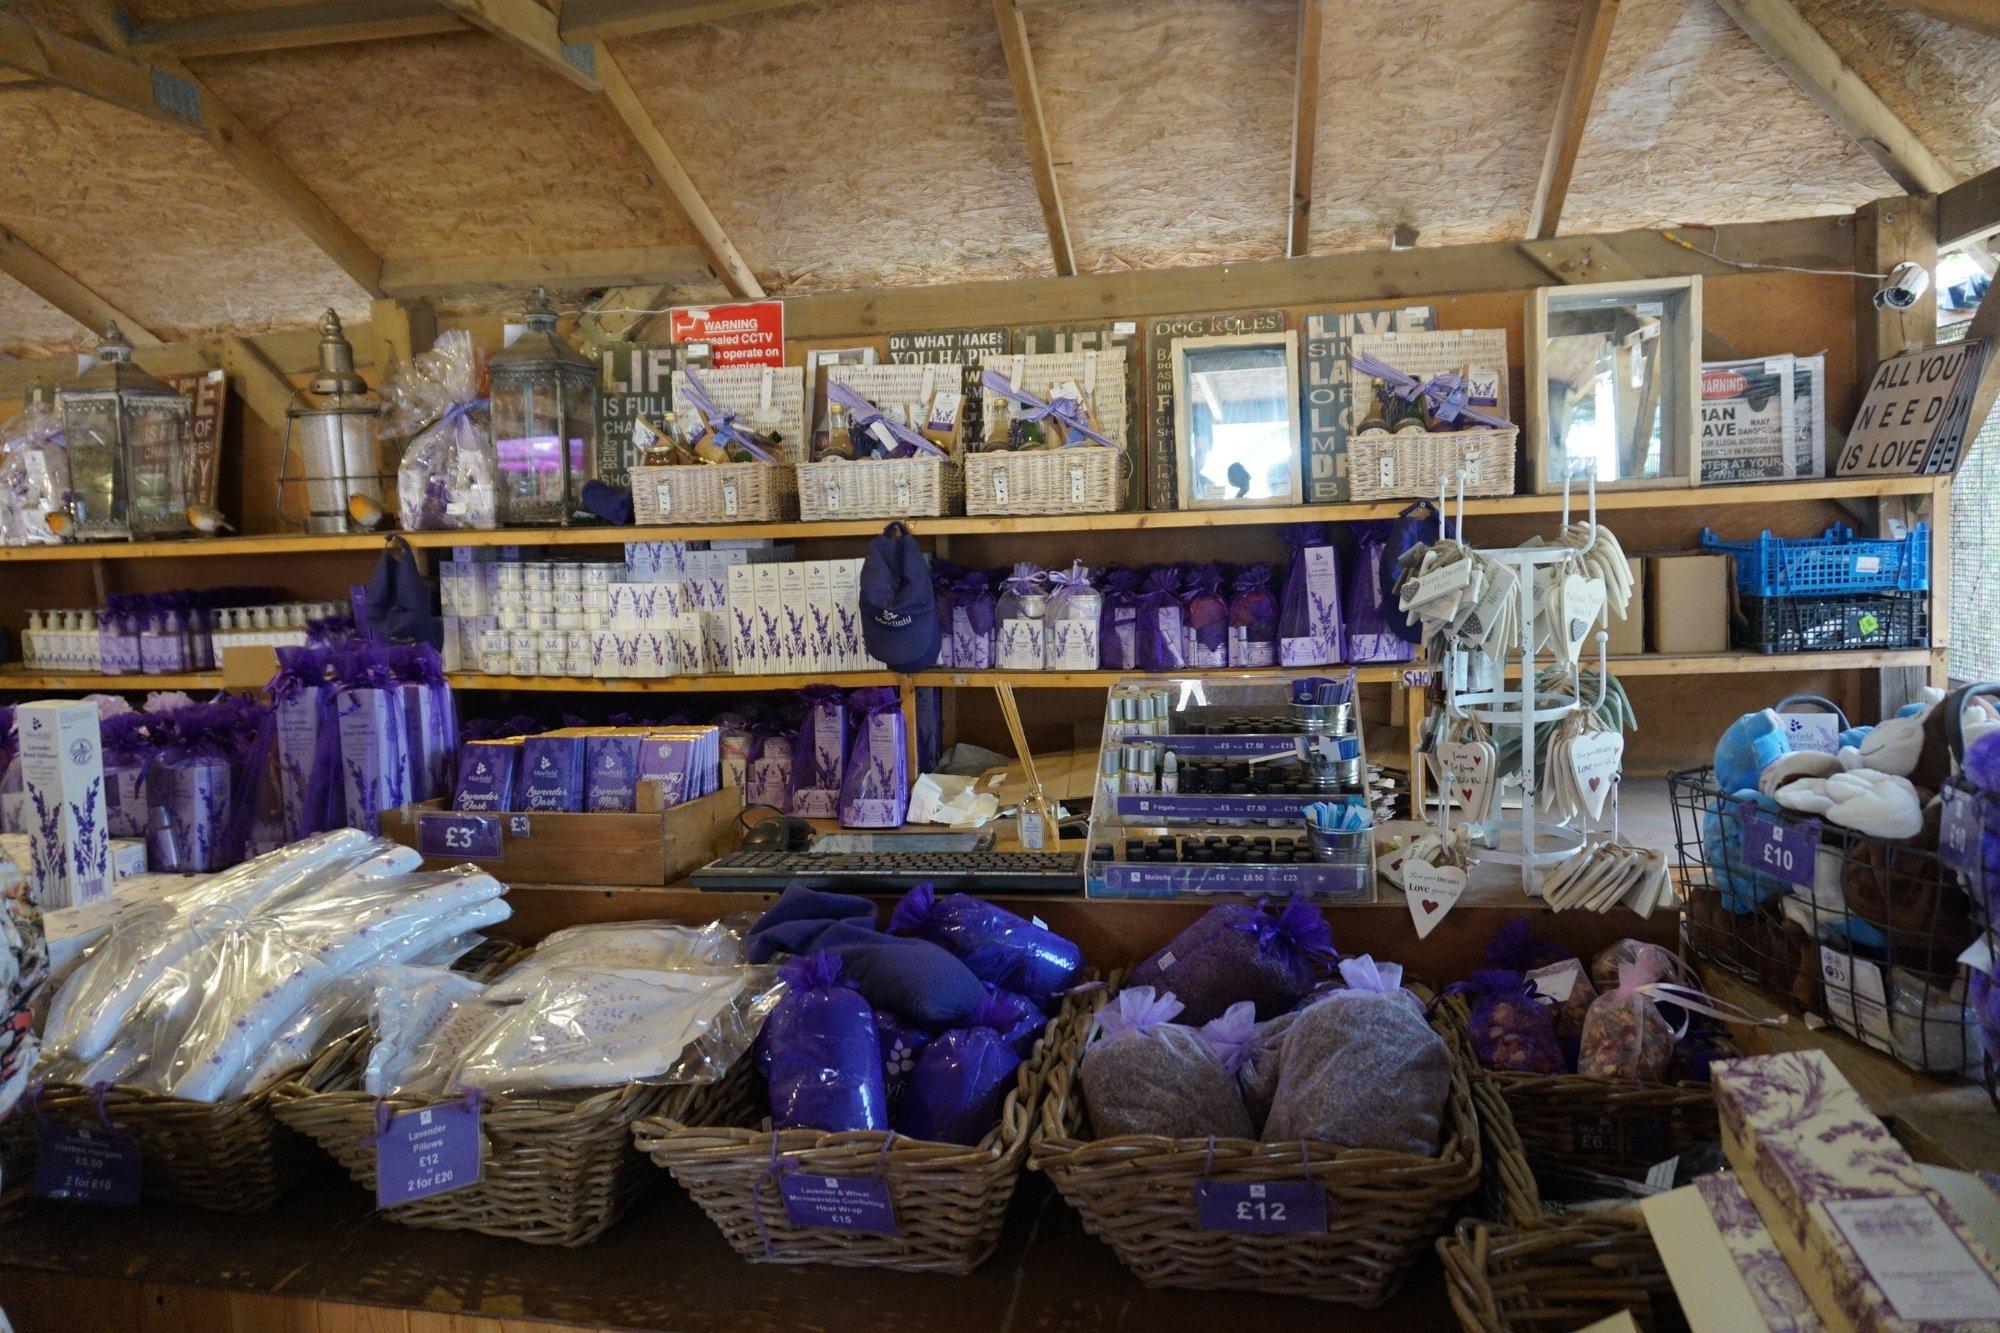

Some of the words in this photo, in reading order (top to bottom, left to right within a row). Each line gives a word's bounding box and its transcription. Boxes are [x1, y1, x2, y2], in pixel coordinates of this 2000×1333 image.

[704, 319, 758, 331] WARNING
[1156, 321, 1203, 336] DOG
[1210, 315, 1277, 333] RULES
[741, 332, 773, 343] CCTV
[890, 337, 909, 350] DO
[914, 335, 954, 347] WHAT
[959, 332, 1003, 346] MAKES
[723, 349, 763, 360] operate
[765, 348, 779, 357] on
[891, 351, 928, 365] YOU
[1874, 361, 1911, 391] ALL
[1915, 352, 1962, 385] YOU
[603, 398, 619, 416] IS
[626, 396, 671, 416] FULL
[1857, 396, 1943, 431] NEED
[194, 419, 213, 438] OF
[1750, 418, 1771, 426] MANY
[1702, 423, 1737, 437] AVE
[1702, 449, 1733, 458] RRENTLY
[1840, 443, 1863, 471] IS
[1866, 438, 1927, 469] LOVE
[1701, 460, 1730, 471] NTER
[1731, 459, 1747, 470] AT
[1748, 457, 1783, 469] YOUR
[1738, 468, 1766, 479] RISK
[1404, 670, 1429, 687] SHO
[1245, 742, 1264, 750] £7.50
[457, 789, 500, 803] Lavender
[525, 785, 569, 799] Lavender
[590, 785, 633, 797] Lavender
[511, 816, 529, 833] £3
[445, 826, 472, 848] £3
[1763, 843, 1793, 871] £10
[1409, 882, 1431, 894] Love
[408, 1124, 447, 1141] Lavender
[413, 1139, 444, 1153] Pillows
[419, 1153, 440, 1168] £12
[407, 1180, 415, 1192] 2
[416, 1177, 433, 1190] for
[434, 1169, 454, 1185] £20
[801, 1187, 837, 1196] Lavender
[815, 1204, 837, 1213] Heat
[838, 1205, 863, 1215] Wrap
[1236, 1200, 1287, 1221] £12
